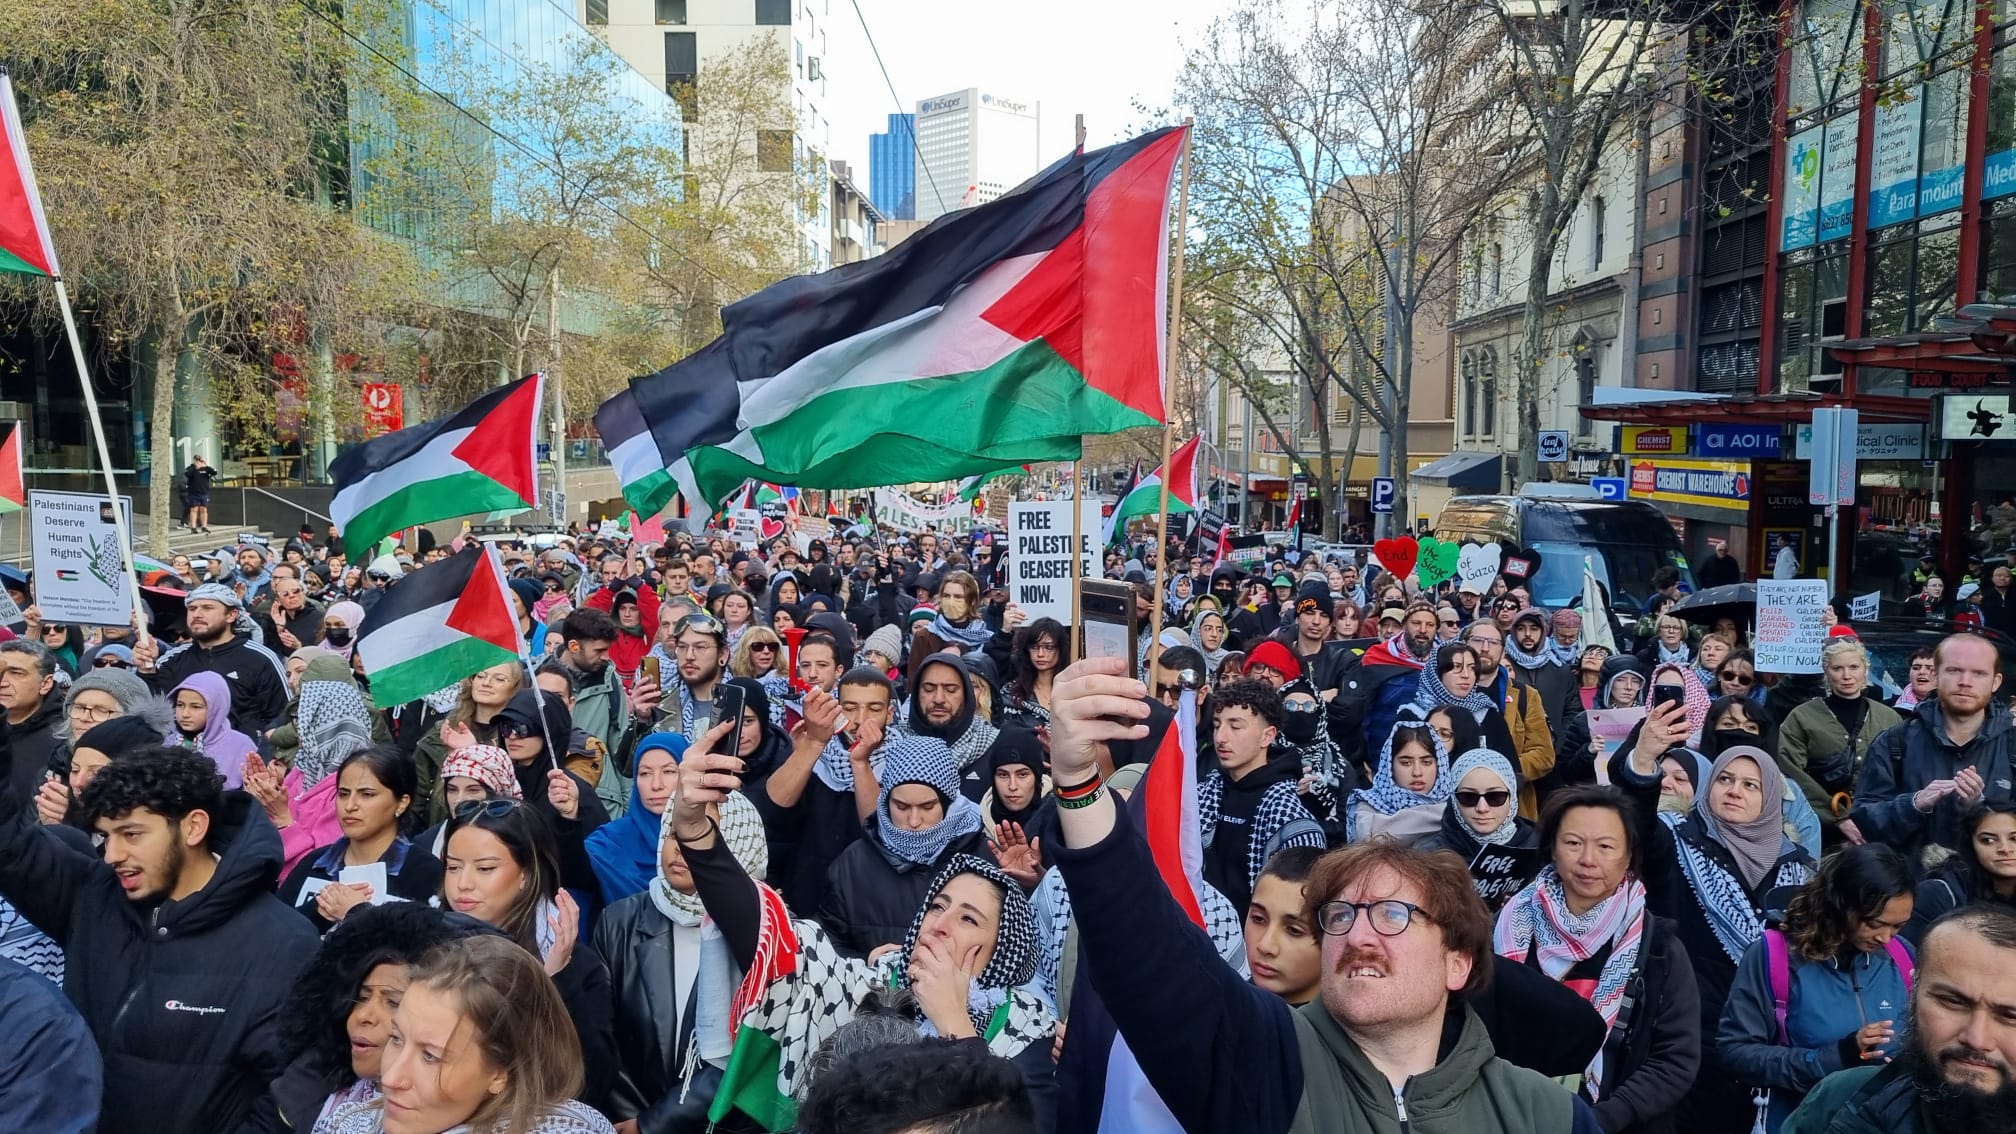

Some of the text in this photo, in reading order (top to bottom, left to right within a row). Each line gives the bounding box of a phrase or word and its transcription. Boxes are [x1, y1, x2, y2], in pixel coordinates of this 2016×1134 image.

[930, 97, 960, 112] UniSuper
[992, 95, 1027, 112] UniSuper
[1637, 436, 1671, 444] CHEMIST
[1730, 434, 1760, 447] AOI
[1884, 434, 1919, 446] Clinic
[1581, 457, 1600, 473] house
[1377, 480, 1393, 501] P
[1656, 471, 1734, 495] CHEMIST WAREHOUSE
[1601, 484, 1616, 499] P
[34, 499, 95, 512] Palestinians
[1768, 496, 1805, 505] ULTRA
[44, 516, 85, 528] Deserve
[1018, 511, 1051, 530] FREE
[48, 532, 83, 543] Human
[50, 547, 82, 559] Rights
[1019, 535, 1093, 556] PALESTIE,
[1423, 545, 1440, 561] the
[1382, 550, 1409, 561] End
[1460, 556, 1472, 570] of
[1019, 560, 1090, 579] CEASEFIE
[1420, 557, 1449, 581] Siege
[1466, 562, 1496, 581] Gaza
[1020, 585, 1054, 604] NOW.
[1764, 595, 1793, 605] THEY
[1757, 653, 1821, 666] STOP IT NOW
[1479, 854, 1517, 874] FREE
[165, 999, 226, 1016] Champion
